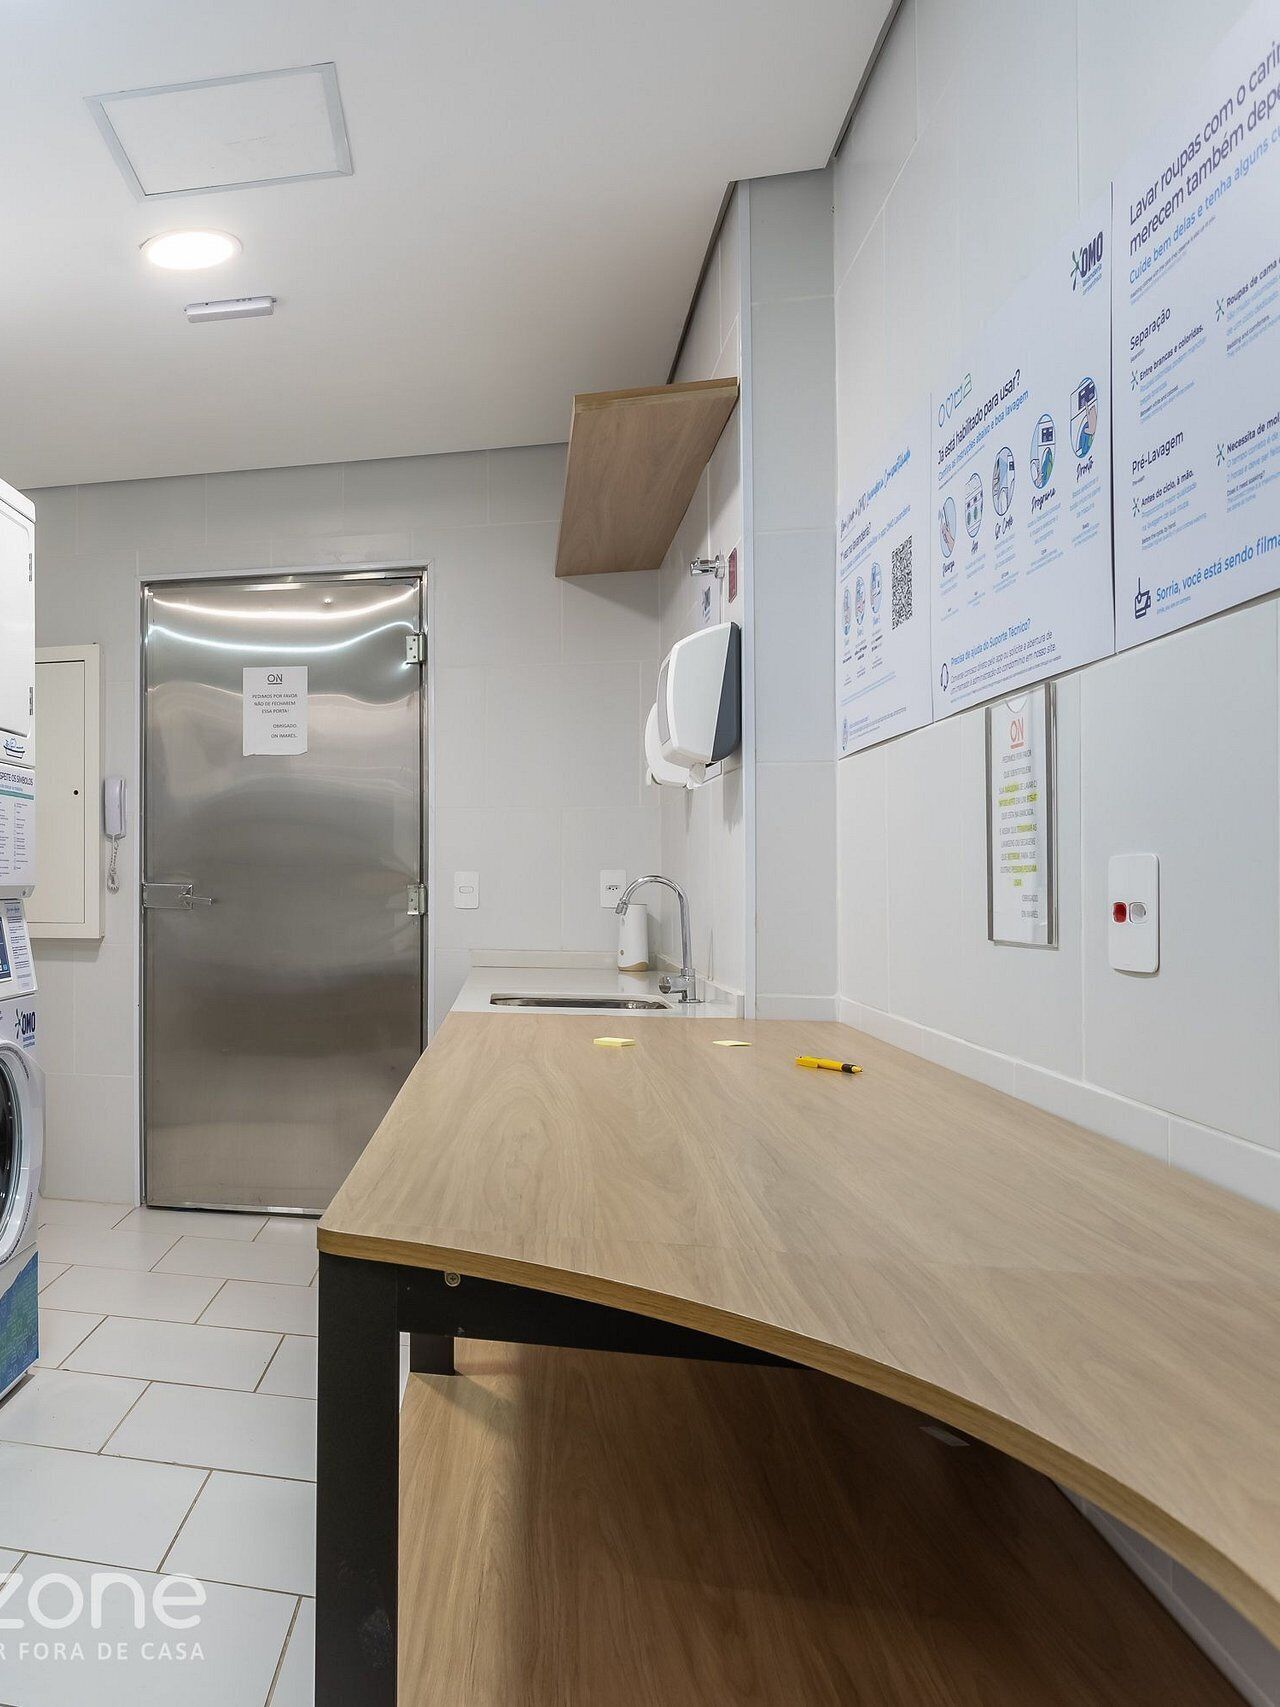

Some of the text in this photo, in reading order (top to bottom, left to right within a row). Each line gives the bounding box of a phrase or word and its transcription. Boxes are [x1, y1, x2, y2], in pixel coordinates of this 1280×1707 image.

[1130, 180, 1158, 226] Lavar
[1161, 133, 1202, 192] roupas
[1204, 97, 1234, 143] com
[1236, 84, 1246, 105] o
[1129, 255, 1151, 284] Cuide
[1153, 237, 1171, 264] bem
[1173, 214, 1195, 244] delas
[1198, 206, 1203, 217] e
[1205, 173, 1232, 210] tenha
[1234, 140, 1269, 183] alguns
[1130, 191, 1184, 256] merecem
[1187, 123, 1243, 197] também
[1080, 231, 1103, 278] OMO
[1227, 259, 1277, 308] Roupas de cama
[1130, 307, 1170, 351] Separação
[1140, 364, 1152, 381] Entre
[1154, 348, 1173, 370] brancas
[1174, 345, 1177, 353] e
[1178, 324, 1203, 350] coloridas.
[945, 434, 955, 457] está
[956, 407, 983, 446] habilitado
[984, 394, 998, 420] para
[1000, 369, 1020, 401] usar?
[1132, 431, 1184, 474] Pré-Lavagem
[1141, 469, 1194, 507] Antes do ciclo, à mão.
[1156, 582, 1181, 602] Sorria,
[1182, 567, 1202, 590] você
[1204, 558, 1222, 580] está
[1224, 545, 1253, 571] sendo
[267, 674, 282, 682] ON
[1010, 717, 1023, 742] ON
[21, 1011, 35, 1035] OMO
